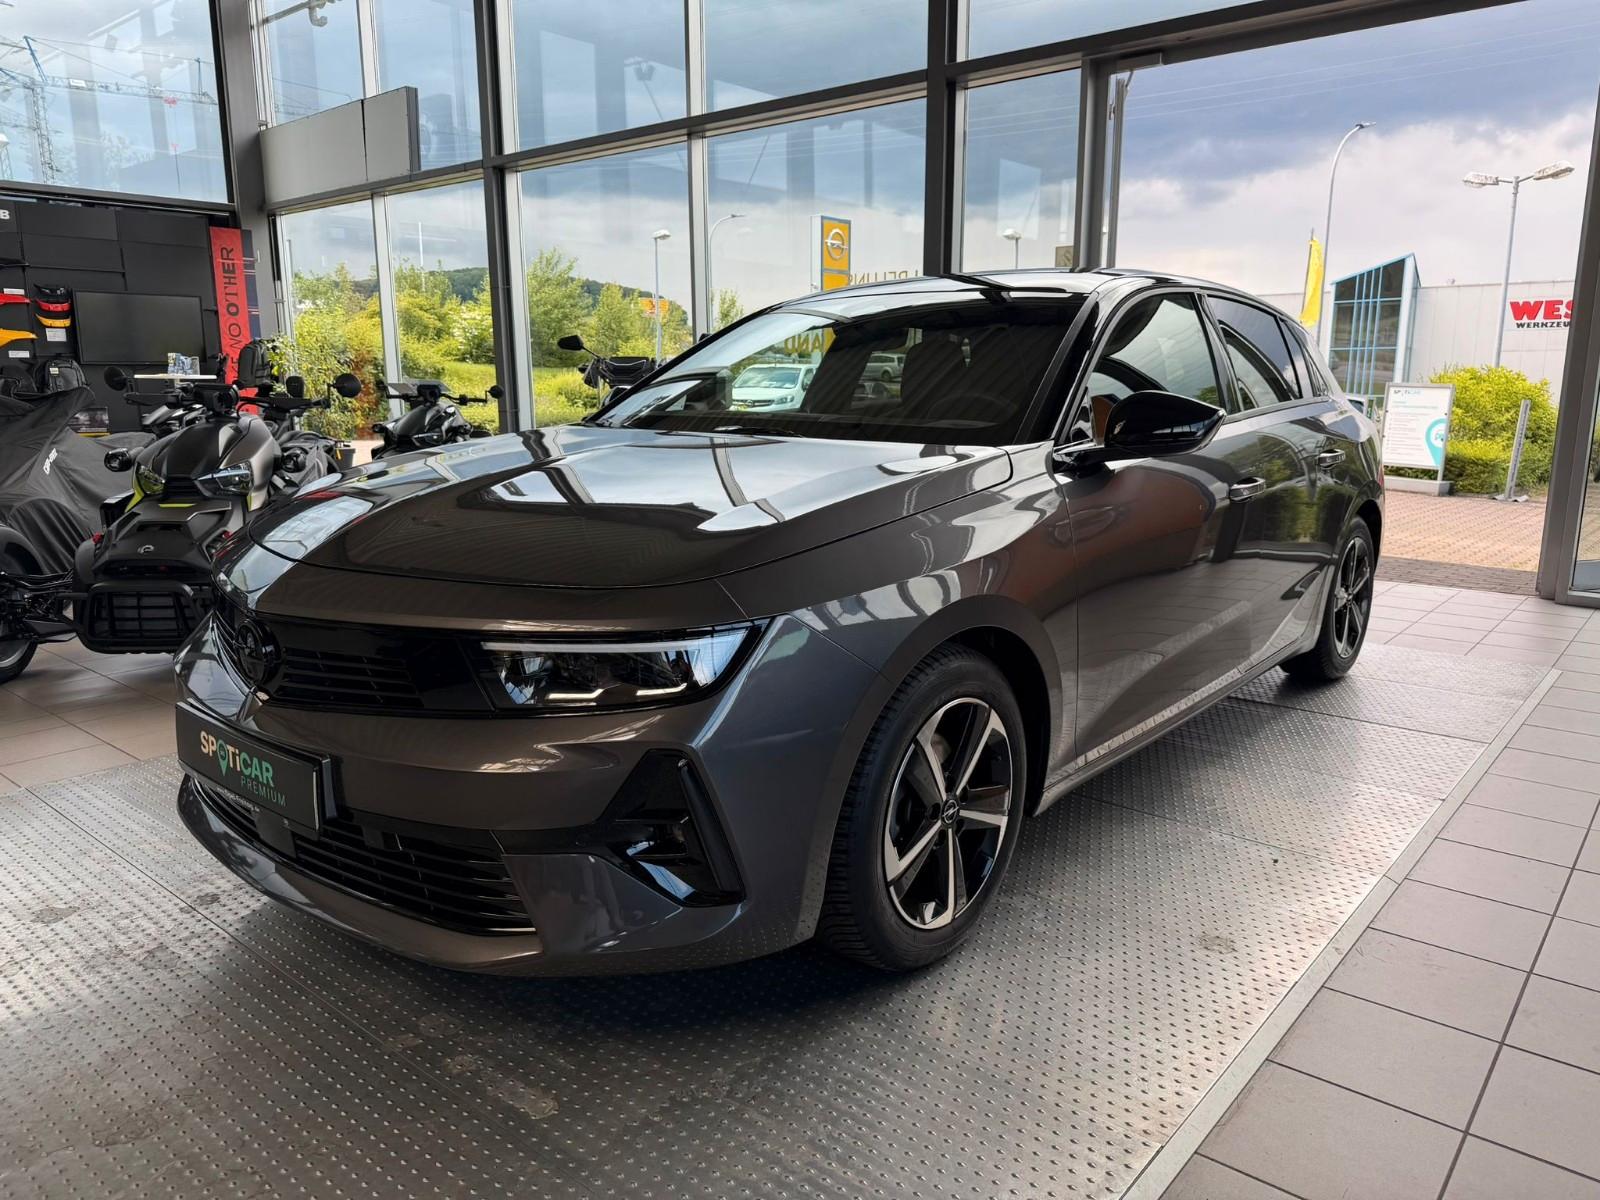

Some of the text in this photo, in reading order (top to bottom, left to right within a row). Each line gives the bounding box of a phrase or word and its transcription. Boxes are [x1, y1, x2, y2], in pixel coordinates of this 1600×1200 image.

[221, 246, 239, 316] OTHER
[228, 323, 242, 348] NO
[241, 776, 287, 807] PREMIUM
